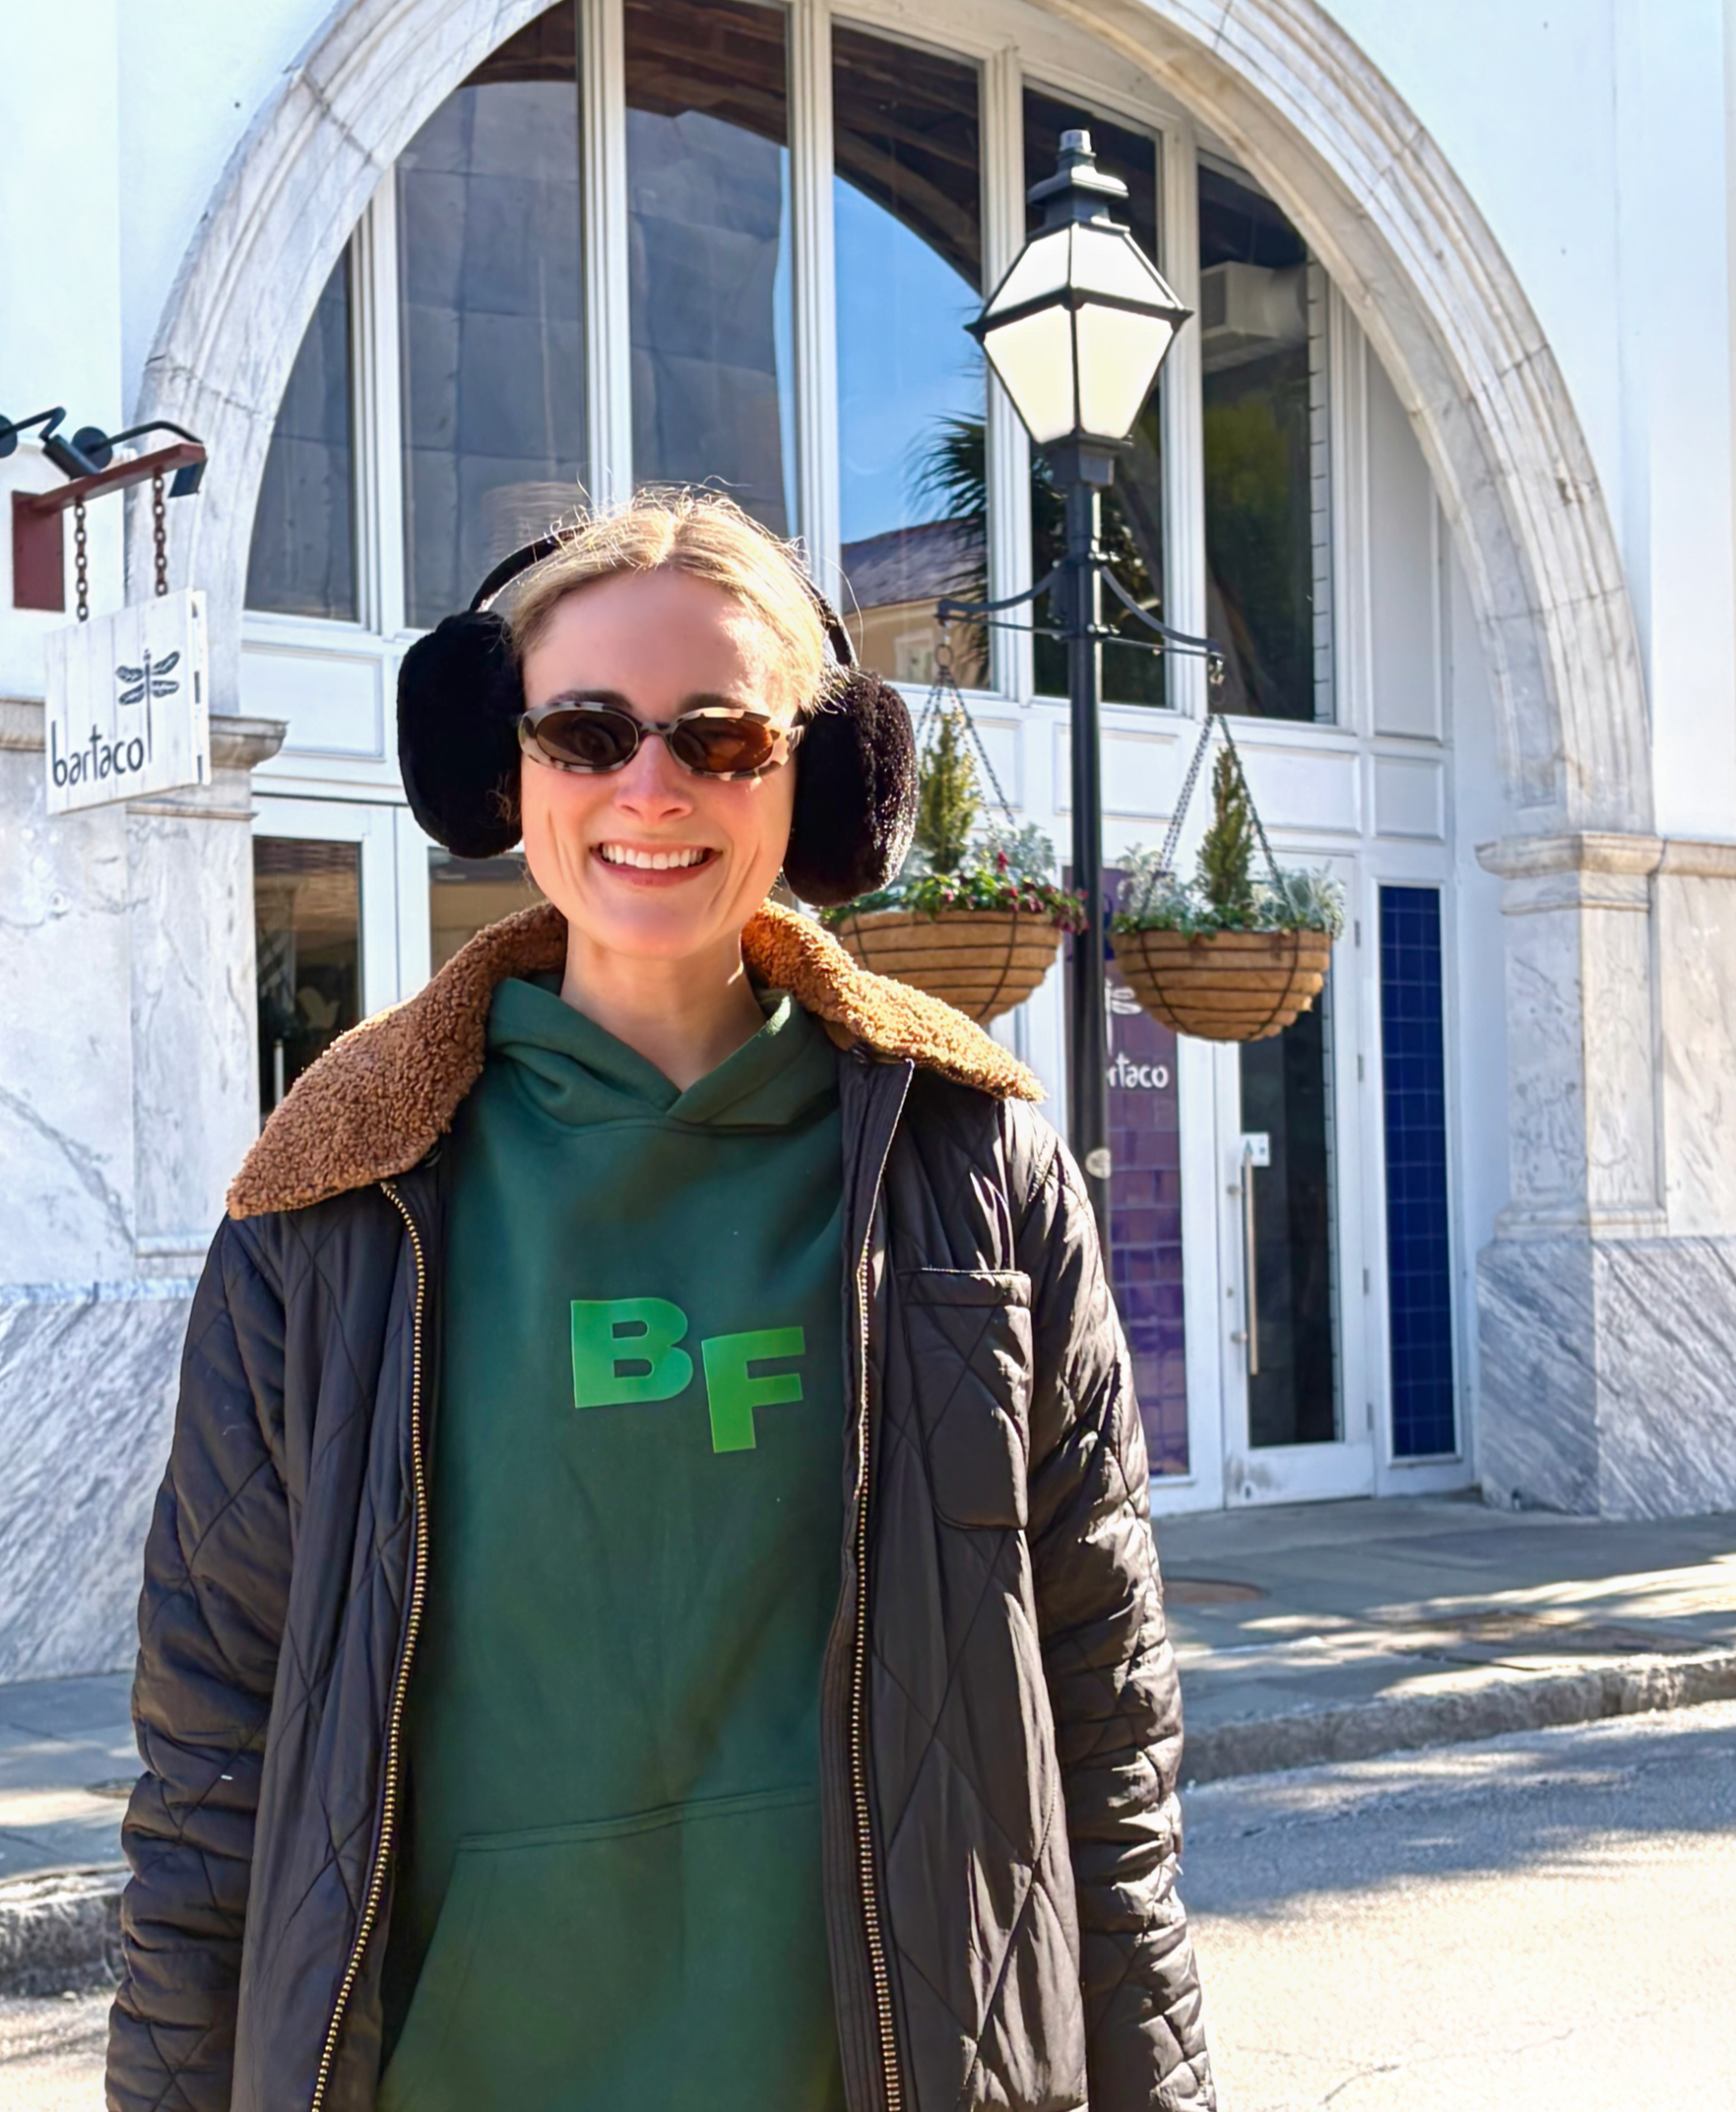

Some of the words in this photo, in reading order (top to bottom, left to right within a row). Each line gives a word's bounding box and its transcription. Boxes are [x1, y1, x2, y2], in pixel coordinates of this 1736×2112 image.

[51, 720, 144, 787] bartaco
[1108, 1051, 1169, 1088] rtaco
[571, 1297, 806, 1453] BF
